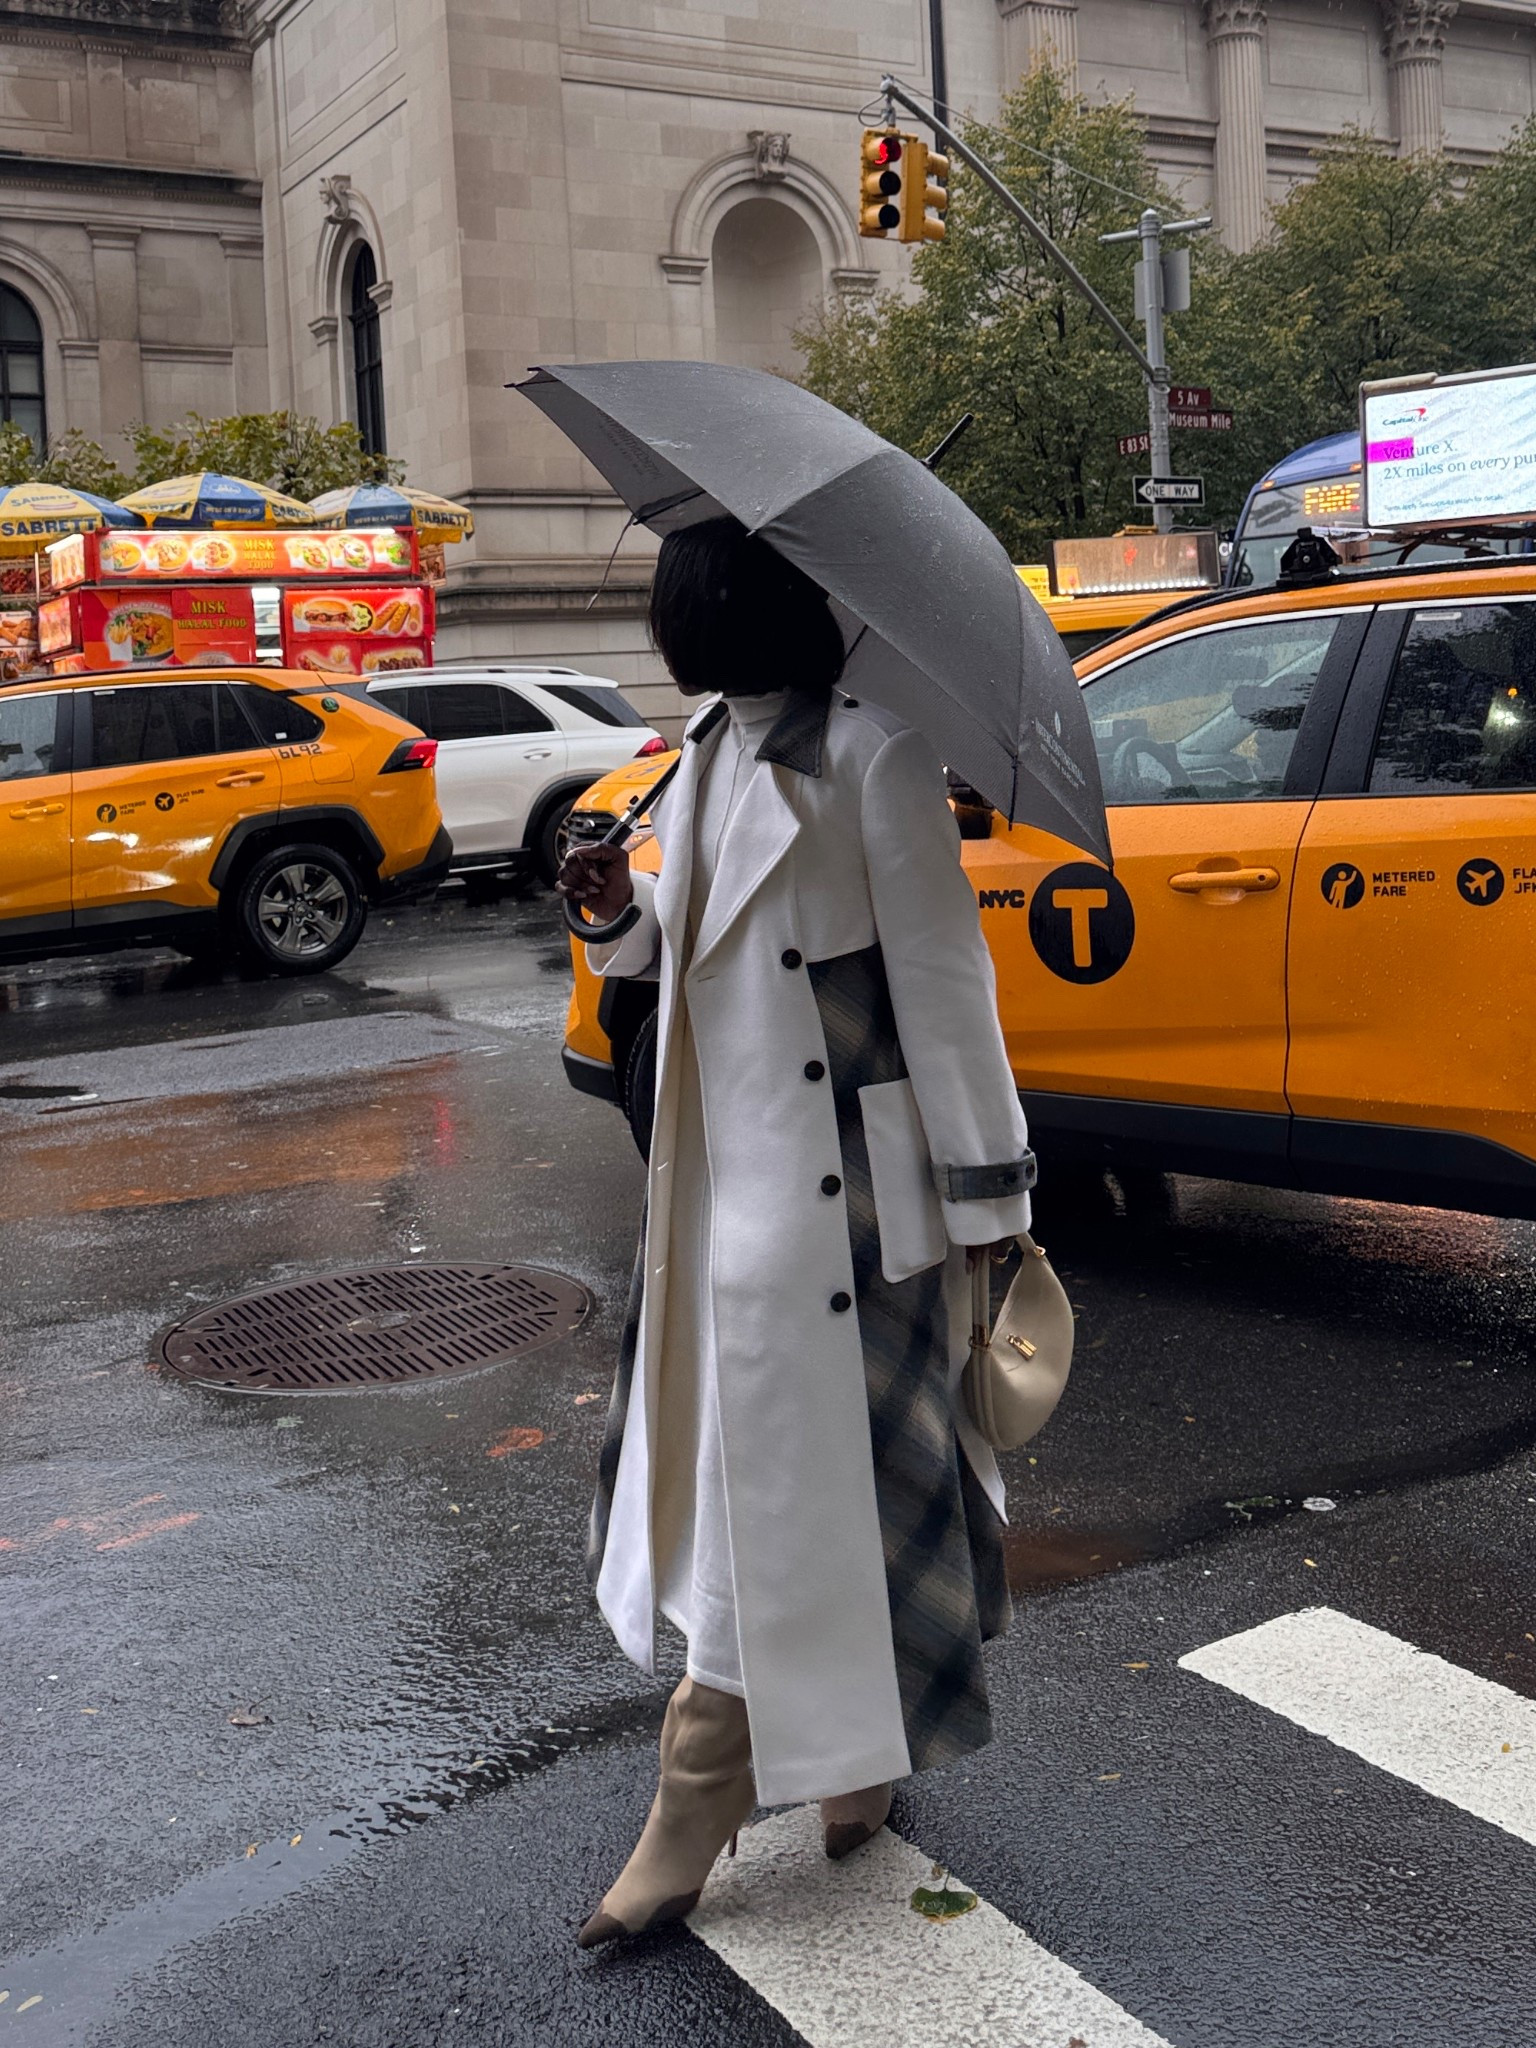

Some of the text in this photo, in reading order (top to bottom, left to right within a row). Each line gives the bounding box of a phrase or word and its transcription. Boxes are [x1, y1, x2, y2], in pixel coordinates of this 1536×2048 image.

[1178, 391, 1199, 406] 5 Av
[1169, 412, 1231, 429] Museum Mile
[1120, 434, 1149, 455] E 83 St
[1383, 440, 1458, 460] Venture X.
[1384, 467, 1402, 480] 2X
[1406, 463, 1444, 477] miles
[1447, 461, 1466, 472] on
[1470, 455, 1510, 470] every
[1145, 485, 1194, 497] ONE WAY
[2, 518, 97, 536] SABRETT
[416, 510, 469, 528] SABRETT
[244, 538, 275, 550] MISK
[191, 601, 226, 614] MISK
[178, 618, 247, 629] HALAL FOOD
[1372, 870, 1436, 883] METERED
[1373, 885, 1407, 897] FARE
[979, 888, 1109, 967] NYC T
